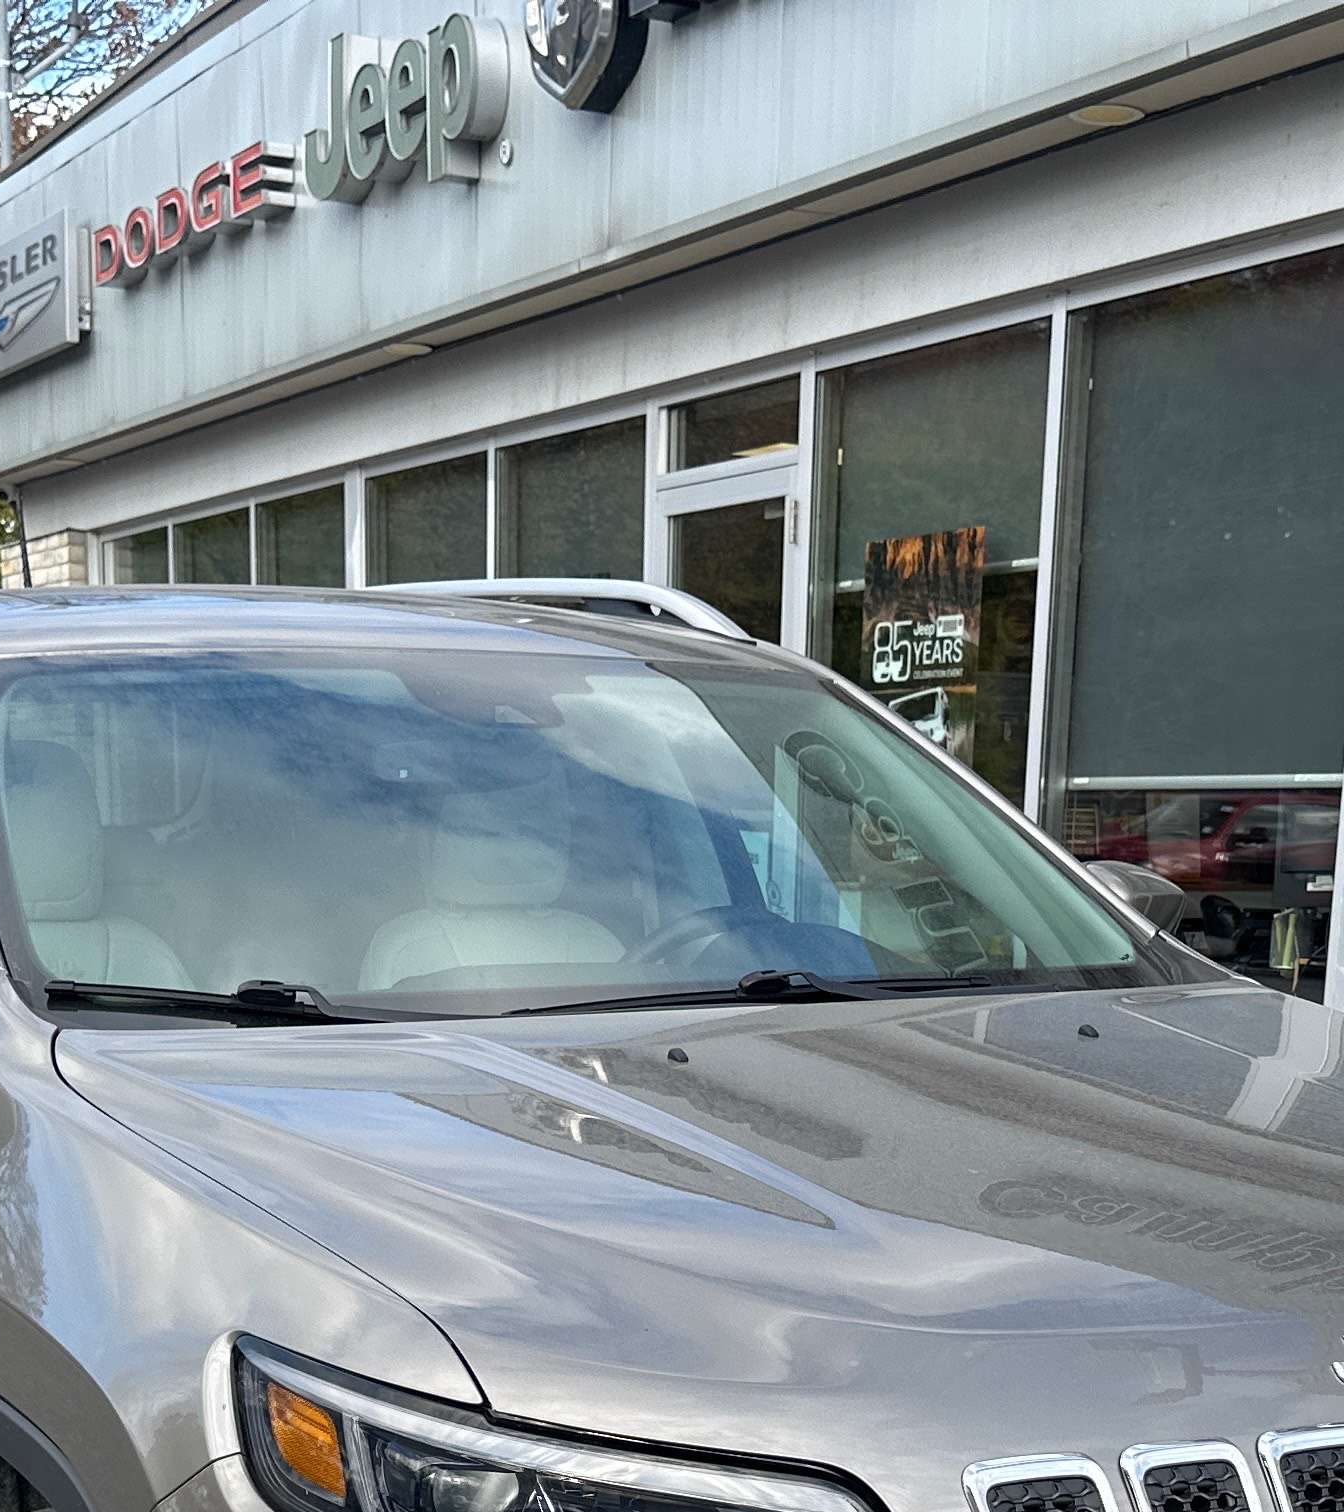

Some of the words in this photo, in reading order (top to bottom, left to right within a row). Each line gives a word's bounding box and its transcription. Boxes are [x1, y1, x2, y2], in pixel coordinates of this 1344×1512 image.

[305, 13, 475, 200] Jeep
[94, 144, 266, 286] DODGE
[872, 620, 913, 684] 85
[913, 622, 935, 638] Jeep
[913, 637, 963, 666] YEARS
